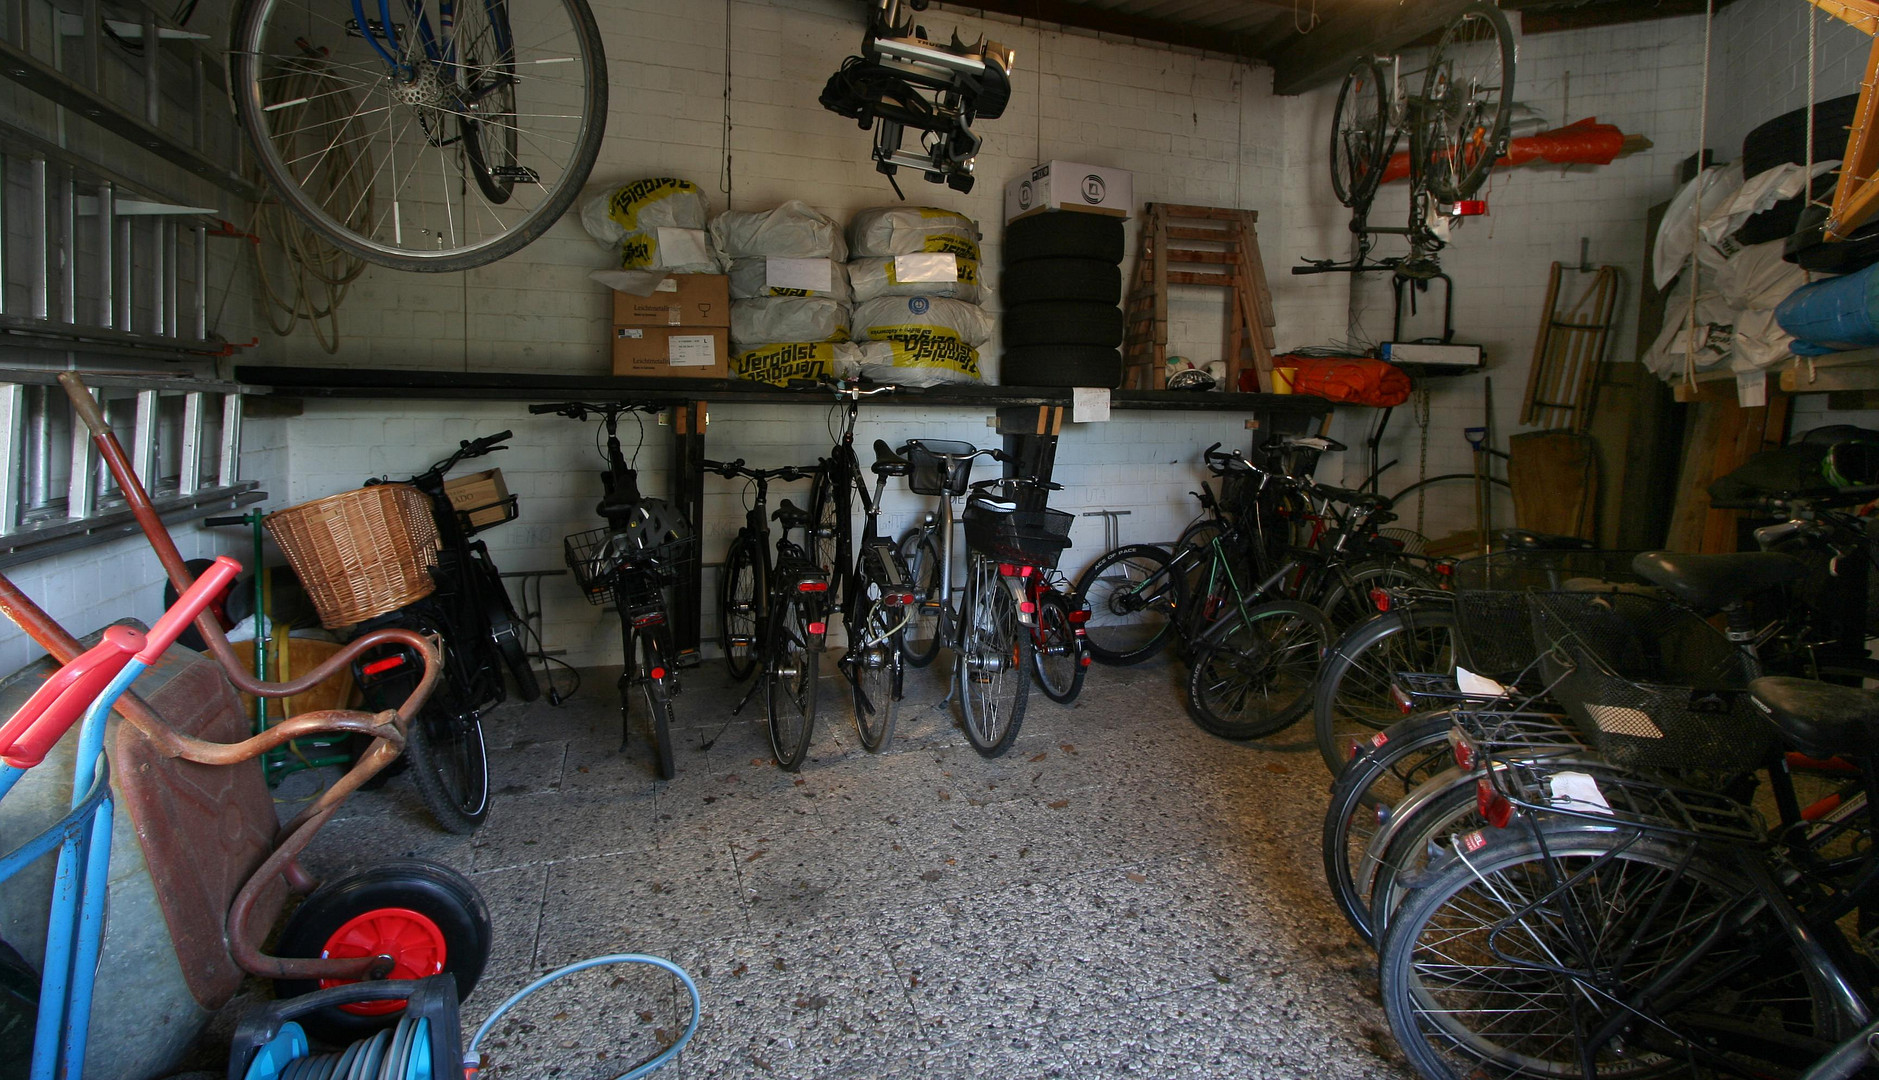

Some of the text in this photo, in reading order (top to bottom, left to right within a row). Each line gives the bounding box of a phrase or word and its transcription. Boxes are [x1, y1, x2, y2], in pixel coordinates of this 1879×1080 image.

[917, 39, 943, 49] THUL
[738, 342, 817, 374] Vergölst
[1094, 559, 1107, 570] ACE
[1118, 547, 1137, 555] PACE
